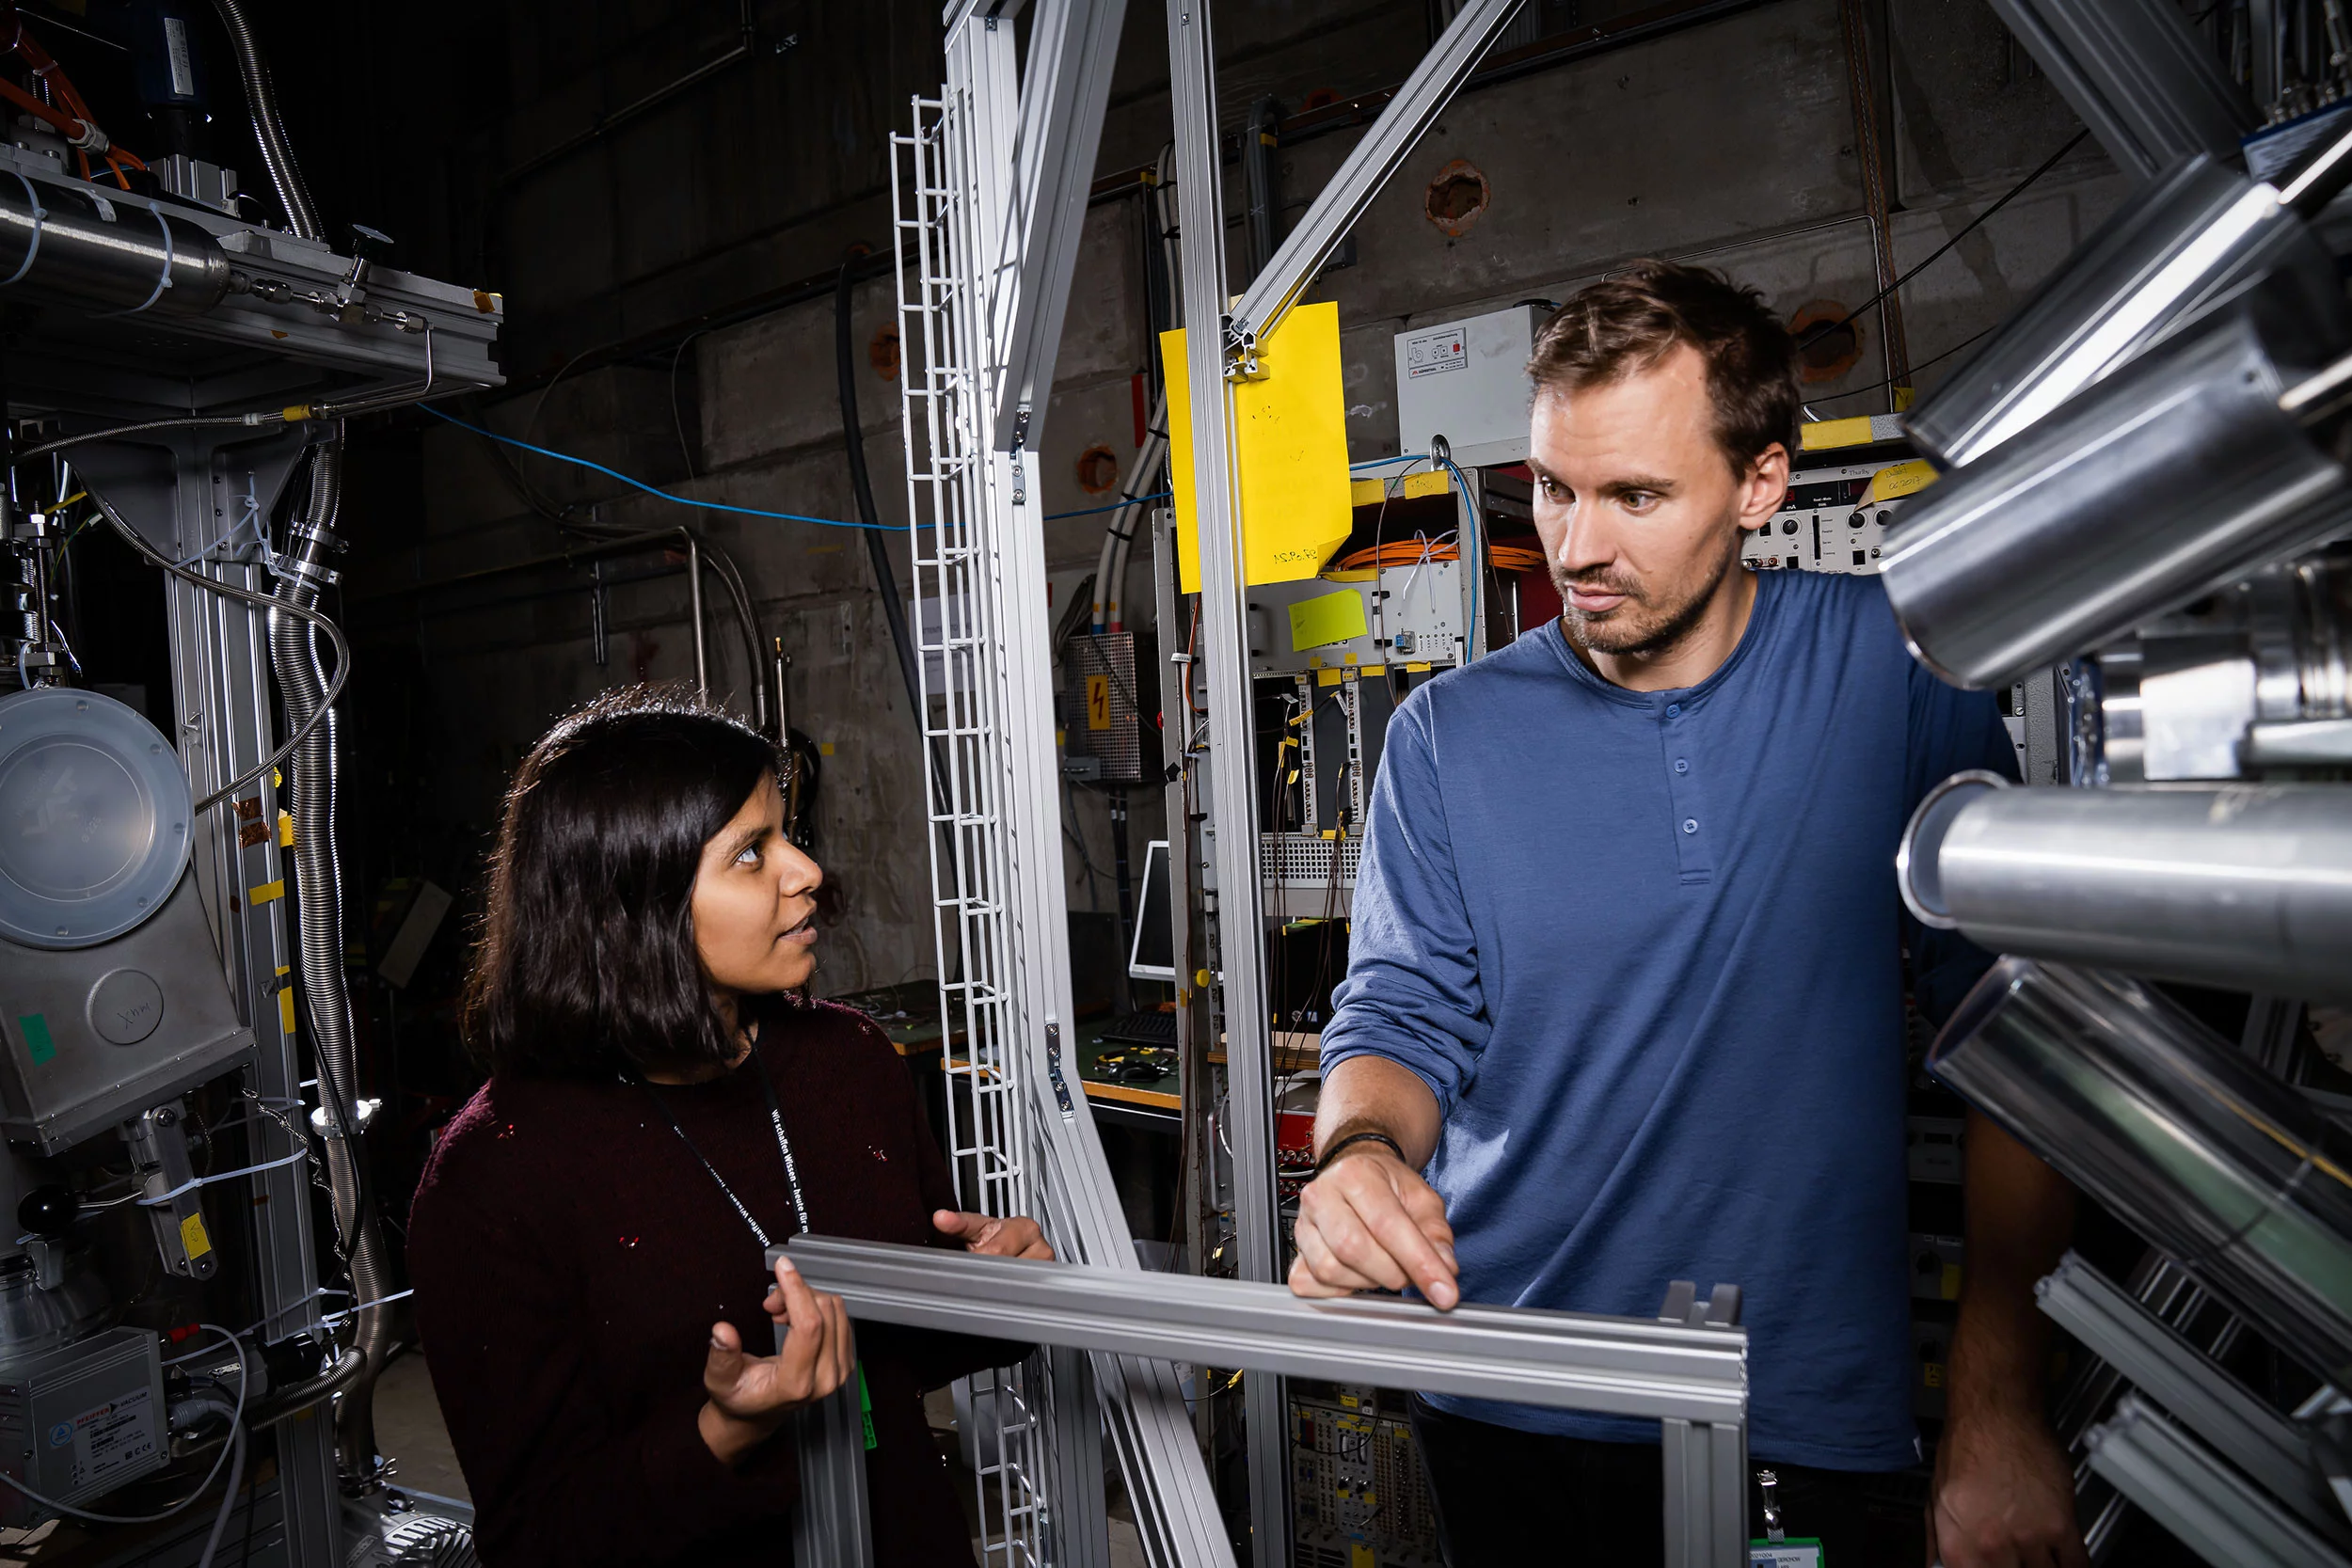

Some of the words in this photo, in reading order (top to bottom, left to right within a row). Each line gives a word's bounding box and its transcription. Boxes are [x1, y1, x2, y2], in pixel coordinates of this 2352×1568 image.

[771, 1108, 781, 1123] Wir
[775, 1123, 789, 1155] schaffen
[784, 1153, 797, 1182] Wissen
[793, 1188, 804, 1212] heute
[799, 1212, 808, 1225] für
[76, 1407, 110, 1426] PFEIFFER
[120, 1391, 148, 1407] VACUUM
